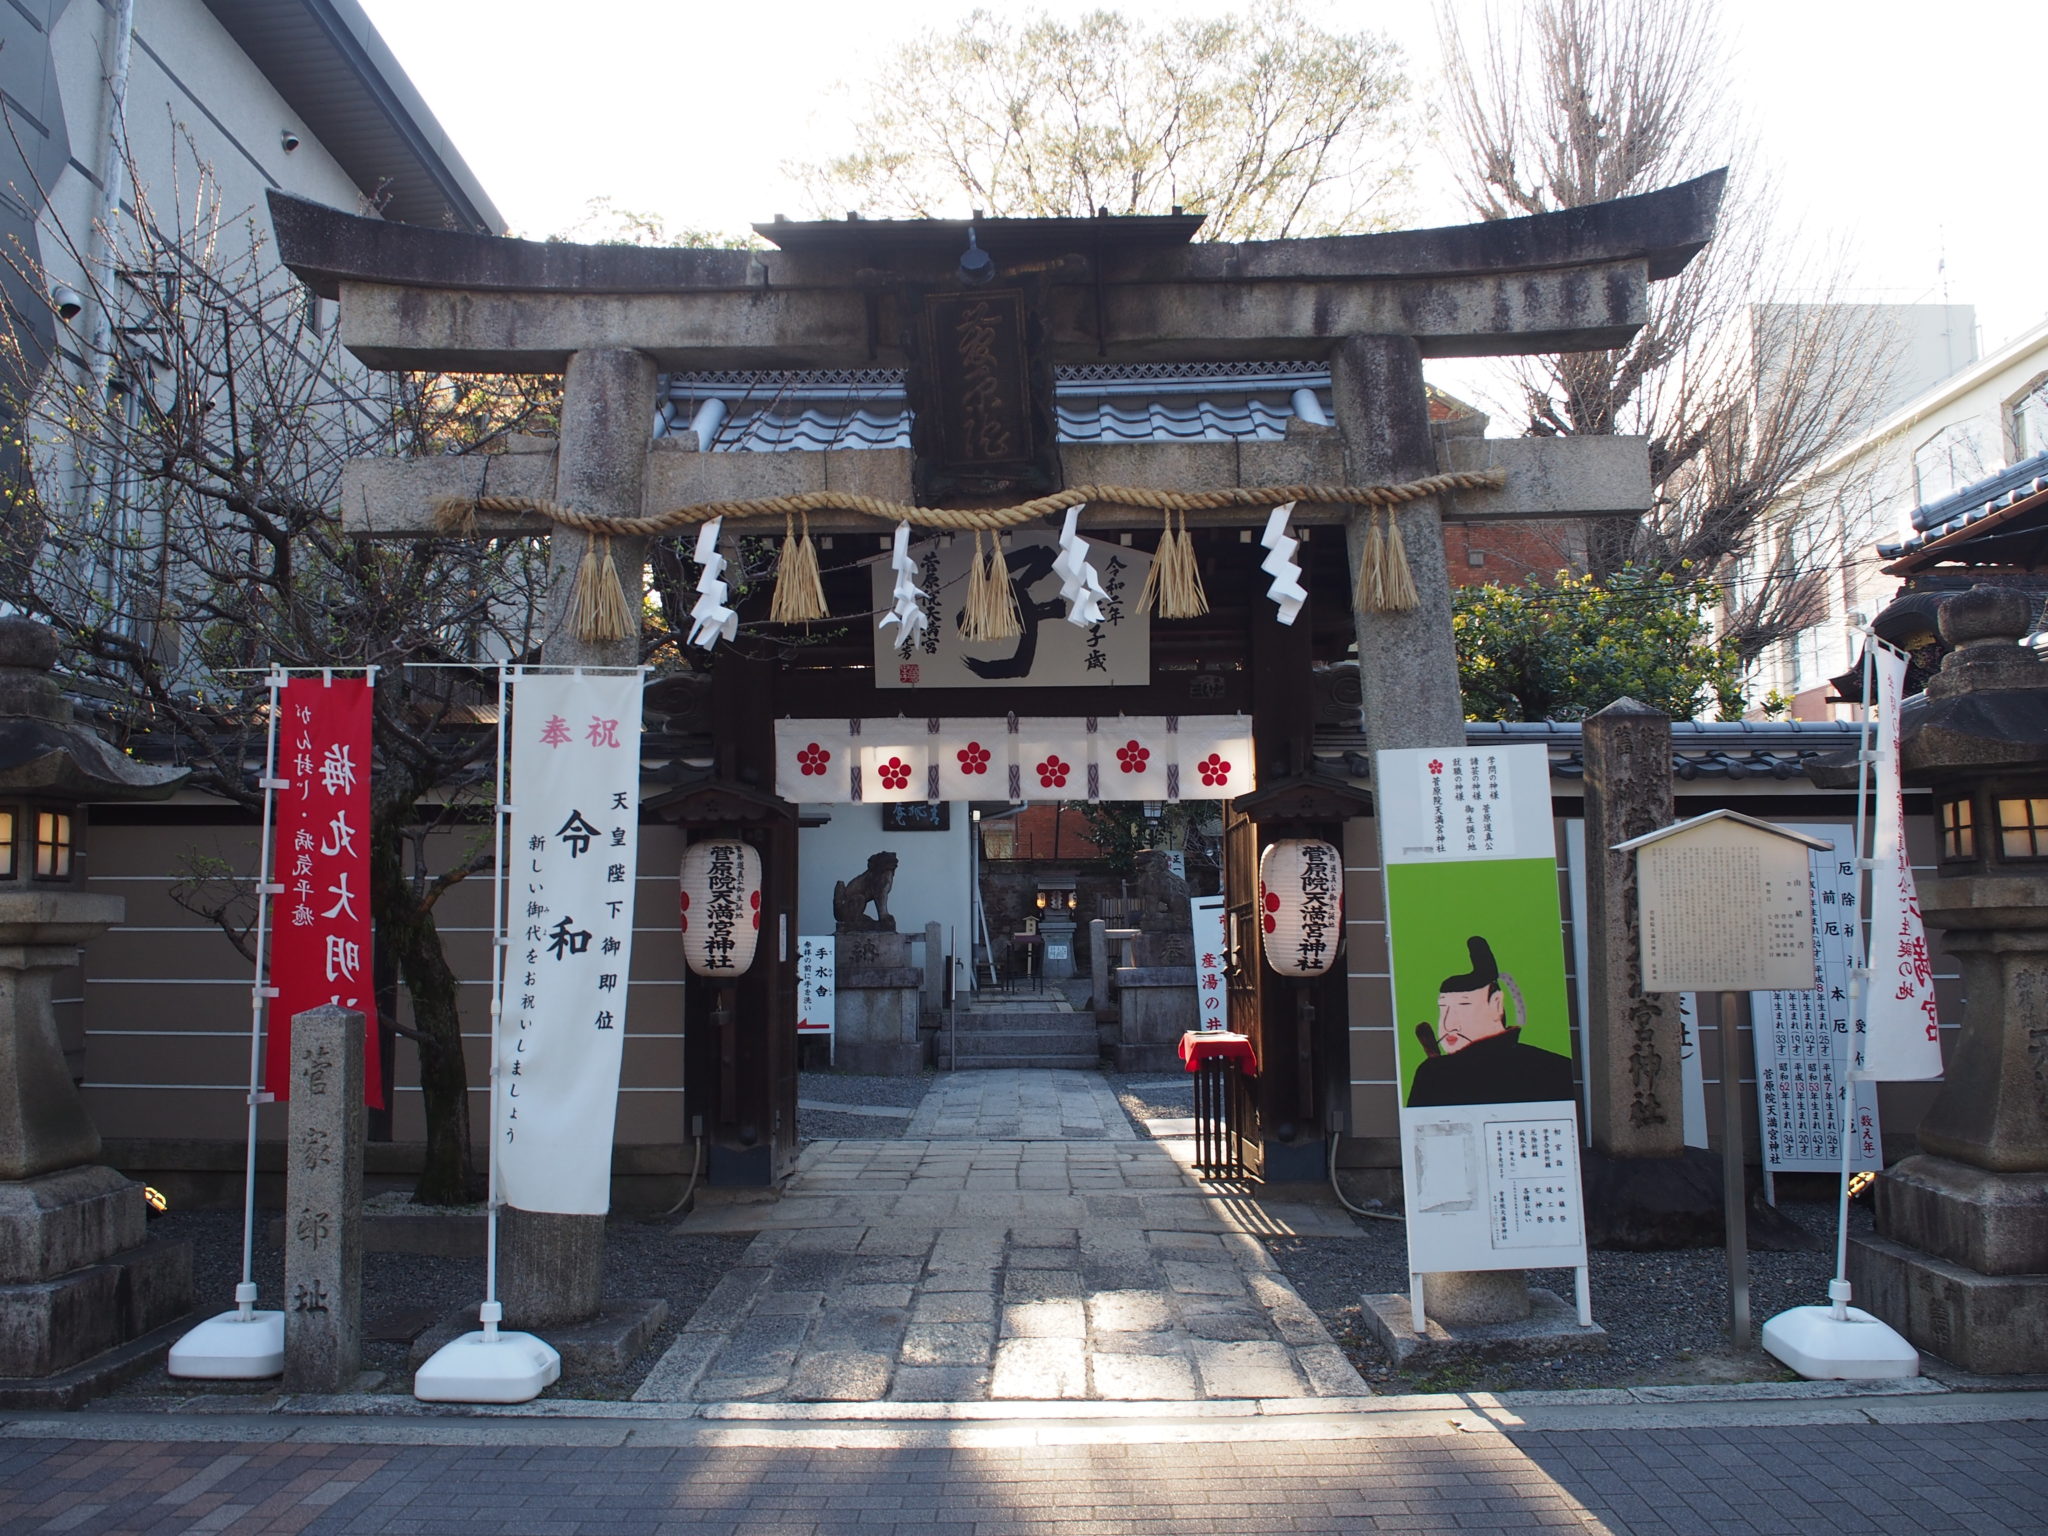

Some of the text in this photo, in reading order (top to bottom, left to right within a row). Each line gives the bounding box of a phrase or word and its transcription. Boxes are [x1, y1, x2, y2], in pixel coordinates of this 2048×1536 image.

[1105, 555, 1127, 626] 令和二年
[1084, 600, 1107, 672] 子歳
[1432, 777, 1447, 852] 菅原院天満宮神社
[1470, 757, 1482, 801] 諸芸の神様
[1487, 756, 1500, 800] 学問の神様
[1465, 805, 1477, 851] 御生誕の地
[1482, 804, 1494, 850] 菅原道真公
[545, 809, 601, 962] 令和
[594, 791, 629, 1031] 天皇陛下御即位
[702, 846, 736, 970] 菅原院天満宮神社
[1293, 846, 1329, 971] 菅原院天満宮神社
[1822, 890, 1840, 936] 前厄
[506, 835, 546, 1144] 新しい御代をお祝いしましょう
[1201, 952, 1222, 1031] 産湯の井
[1773, 989, 1787, 1057] 年生まれ(33才)
[1788, 989, 1801, 1057] 年生まれ(19才)
[1801, 988, 1816, 1057] 年生まれ(42才)
[1831, 987, 1849, 1034] 本厄
[1763, 1069, 1781, 1164] 菅原院天満宮神社
[1779, 1063, 1794, 1157] 昭和62年生まれ(34才)
[1794, 1063, 1809, 1157] 平成13年生まれ(20才)
[1808, 1063, 1823, 1157] 昭和53年生まれ(43才)
[1822, 1063, 1838, 1157] 平成7年生まれ(26才)
[1858, 1106, 1875, 1159] (数え年)
